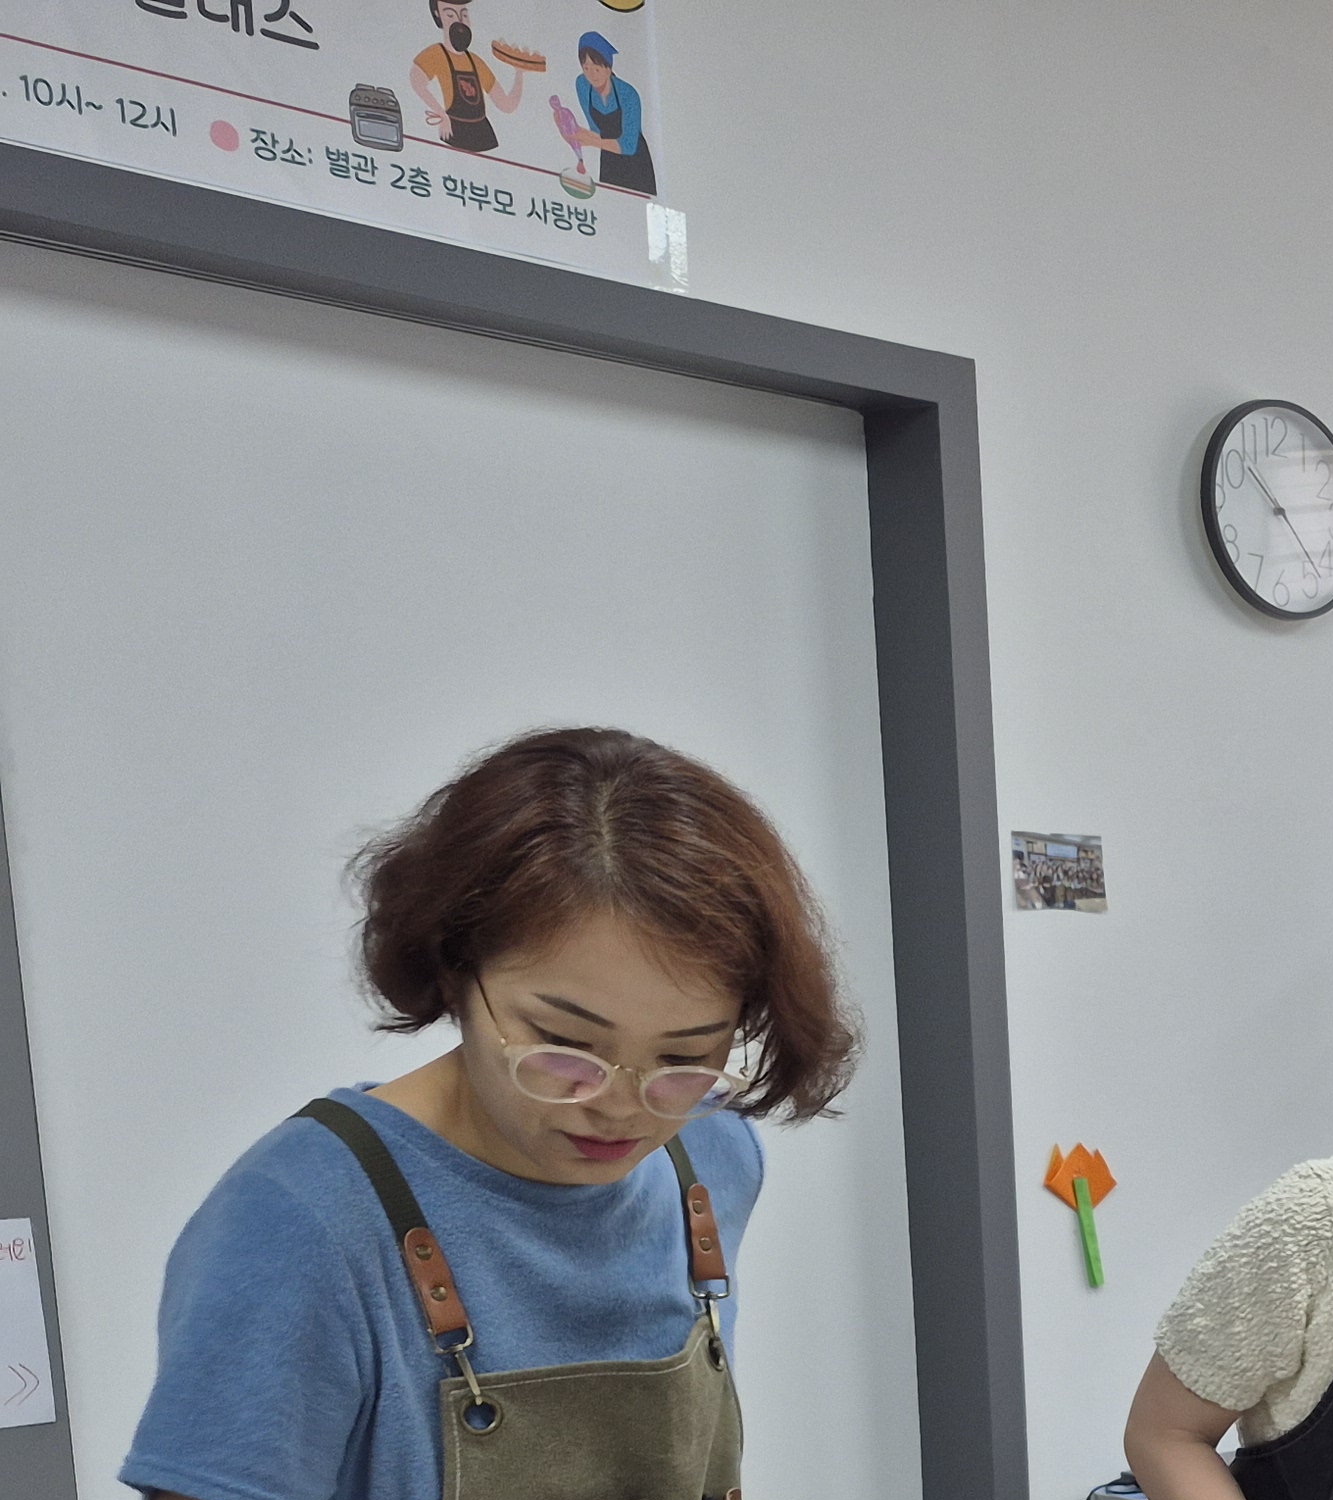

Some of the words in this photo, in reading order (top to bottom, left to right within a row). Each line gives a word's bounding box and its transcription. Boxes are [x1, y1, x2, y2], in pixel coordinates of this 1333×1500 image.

[19, 75, 103, 115] 10시~
[116, 98, 177, 137] 12시
[250, 127, 313, 166] 장소:
[325, 145, 378, 184] 별관
[389, 163, 432, 198] 2층
[442, 174, 517, 217] 학부모
[527, 197, 598, 236] 사랑방
[1241, 421, 1257, 465] 11
[1263, 416, 1288, 459] 12
[1315, 459, 1332, 500] 2
[1272, 569, 1290, 608] 6
[1302, 559, 1319, 600] 5
